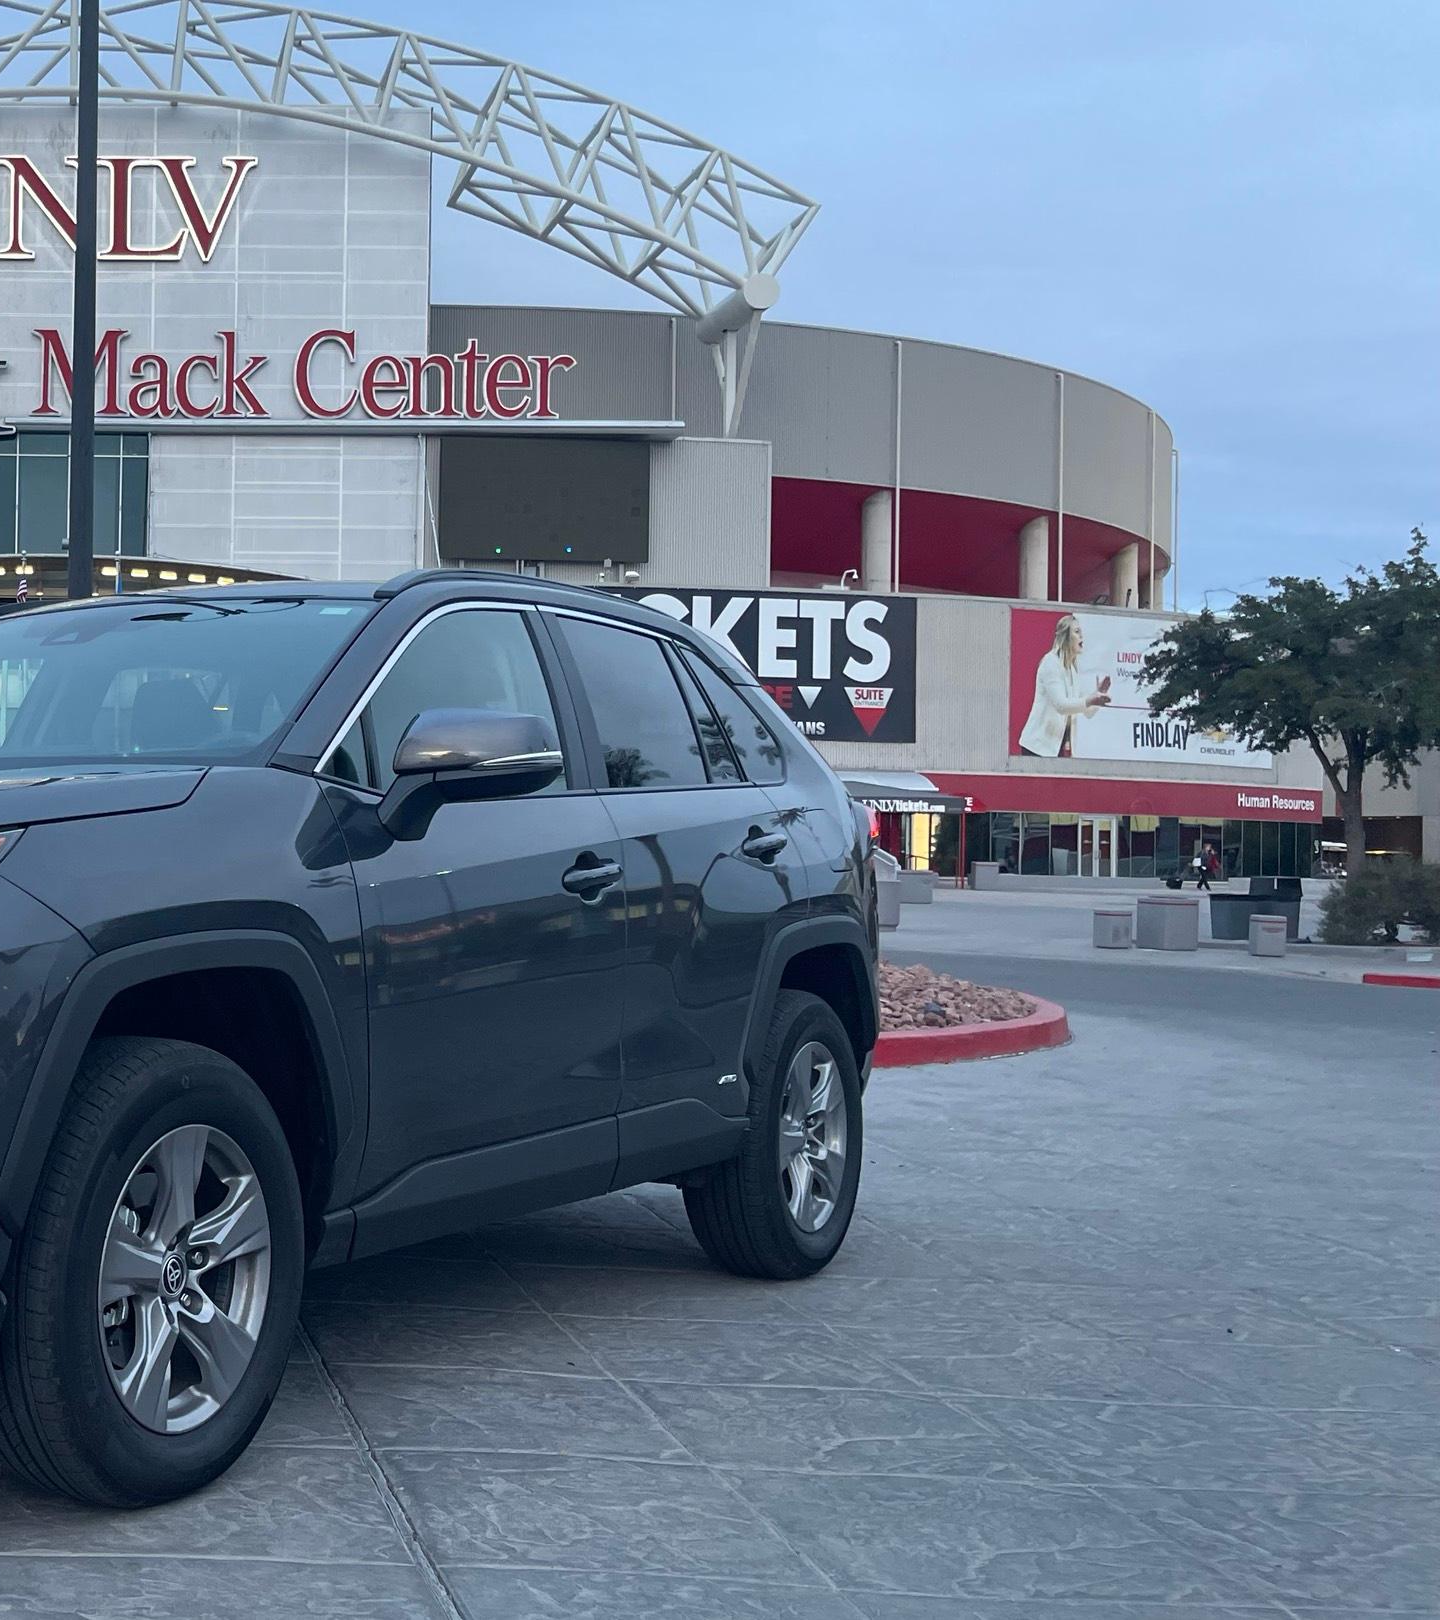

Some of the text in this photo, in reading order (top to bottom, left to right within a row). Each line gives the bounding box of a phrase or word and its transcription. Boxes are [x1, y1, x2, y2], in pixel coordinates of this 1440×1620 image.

[31, 327, 271, 420] Mack
[292, 328, 577, 420] Center
[613, 593, 891, 683] KETS
[1117, 652, 1142, 664] LINDY
[854, 689, 884, 700] SUITE
[1133, 722, 1190, 750] FINDLAY
[1237, 793, 1315, 811] Human Resources
